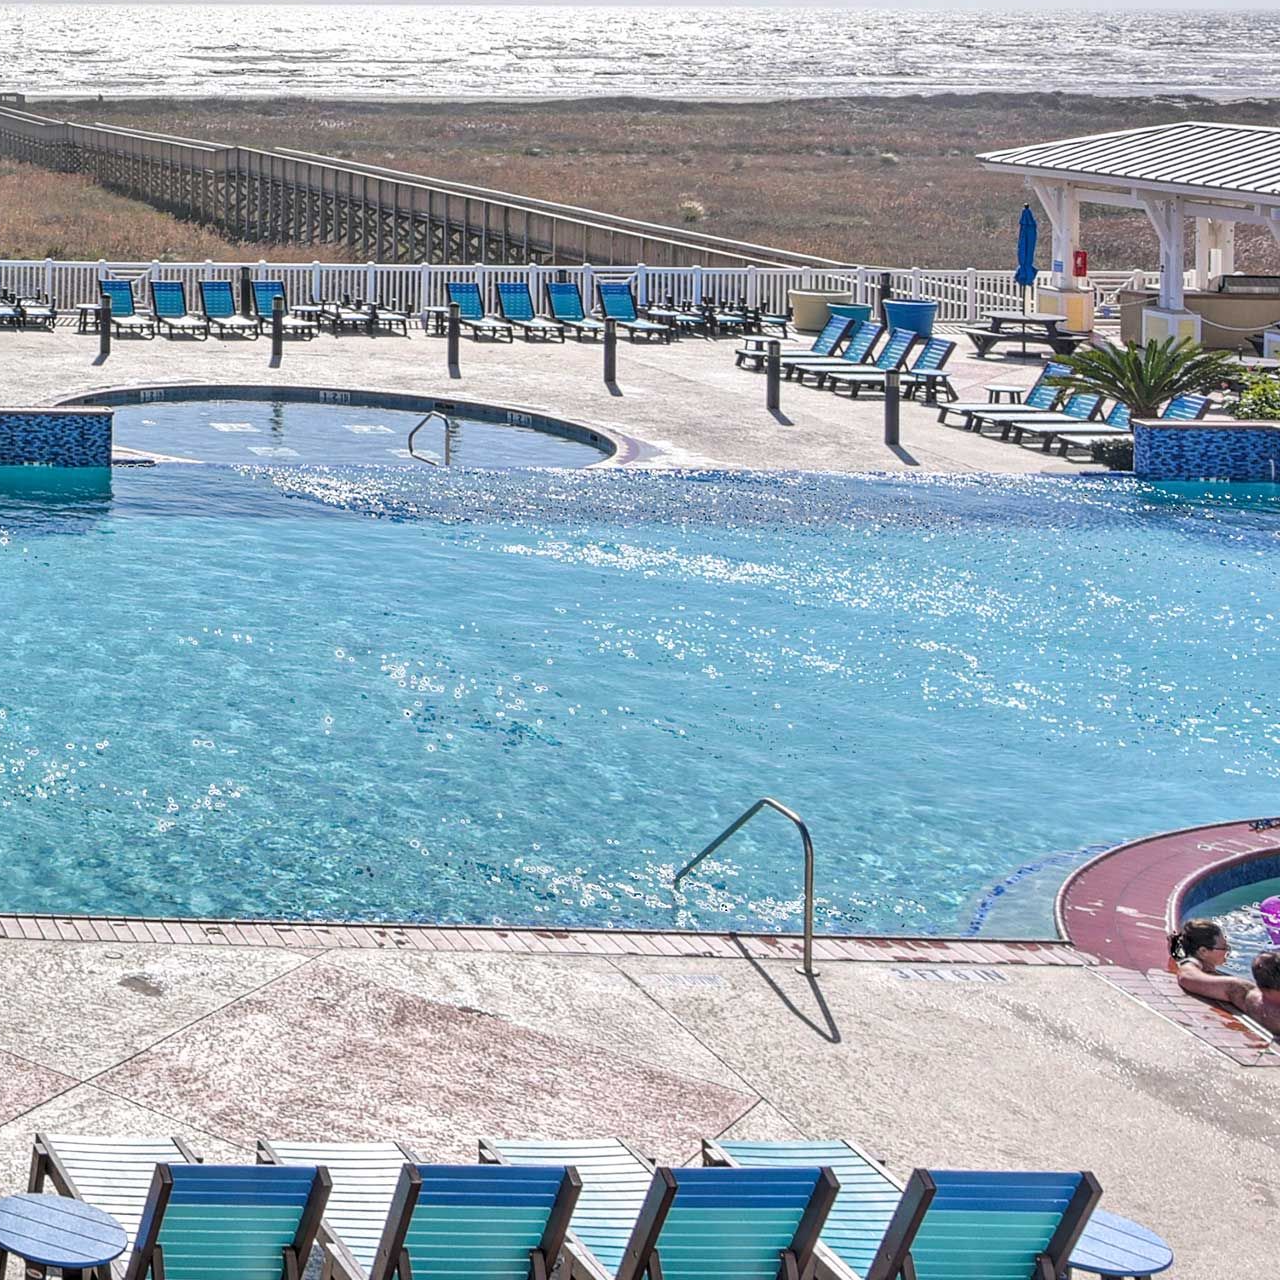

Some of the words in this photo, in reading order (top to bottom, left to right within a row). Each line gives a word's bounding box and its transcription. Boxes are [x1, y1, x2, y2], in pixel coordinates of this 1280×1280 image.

[891, 968, 911, 979] 3
[912, 969, 945, 980] FT
[973, 970, 1007, 981] IN
